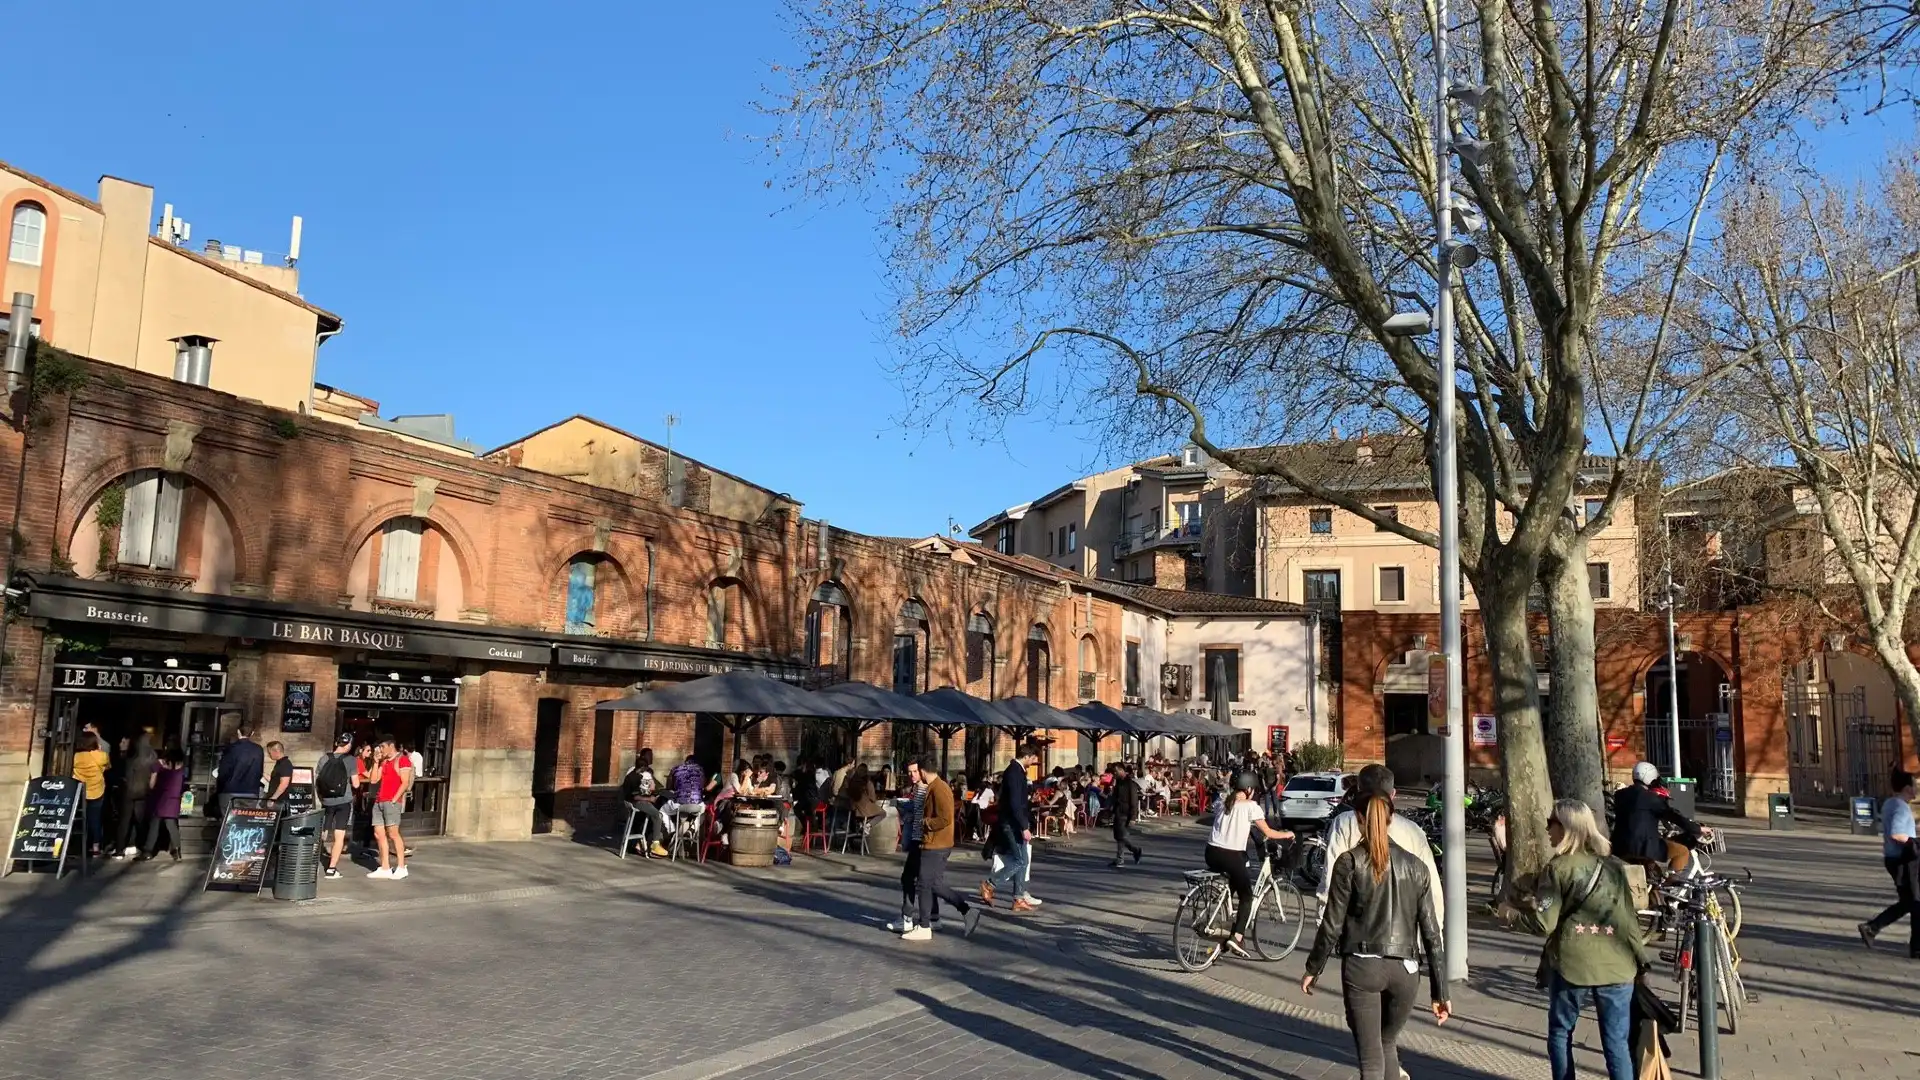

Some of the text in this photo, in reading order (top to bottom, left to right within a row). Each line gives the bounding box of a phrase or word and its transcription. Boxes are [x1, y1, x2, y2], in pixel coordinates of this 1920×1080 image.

[87, 606, 149, 623] Brasserie
[272, 622, 405, 650] LE BAR BASQUE
[488, 647, 523, 659] Cocktail
[644, 658, 659, 669] LES
[660, 660, 694, 671] JARDINS
[695, 664, 707, 672] DU
[709, 664, 723, 674] BAR
[64, 669, 212, 692] LE BAR BASQUE
[344, 684, 448, 702] LE BAR BASQUE
